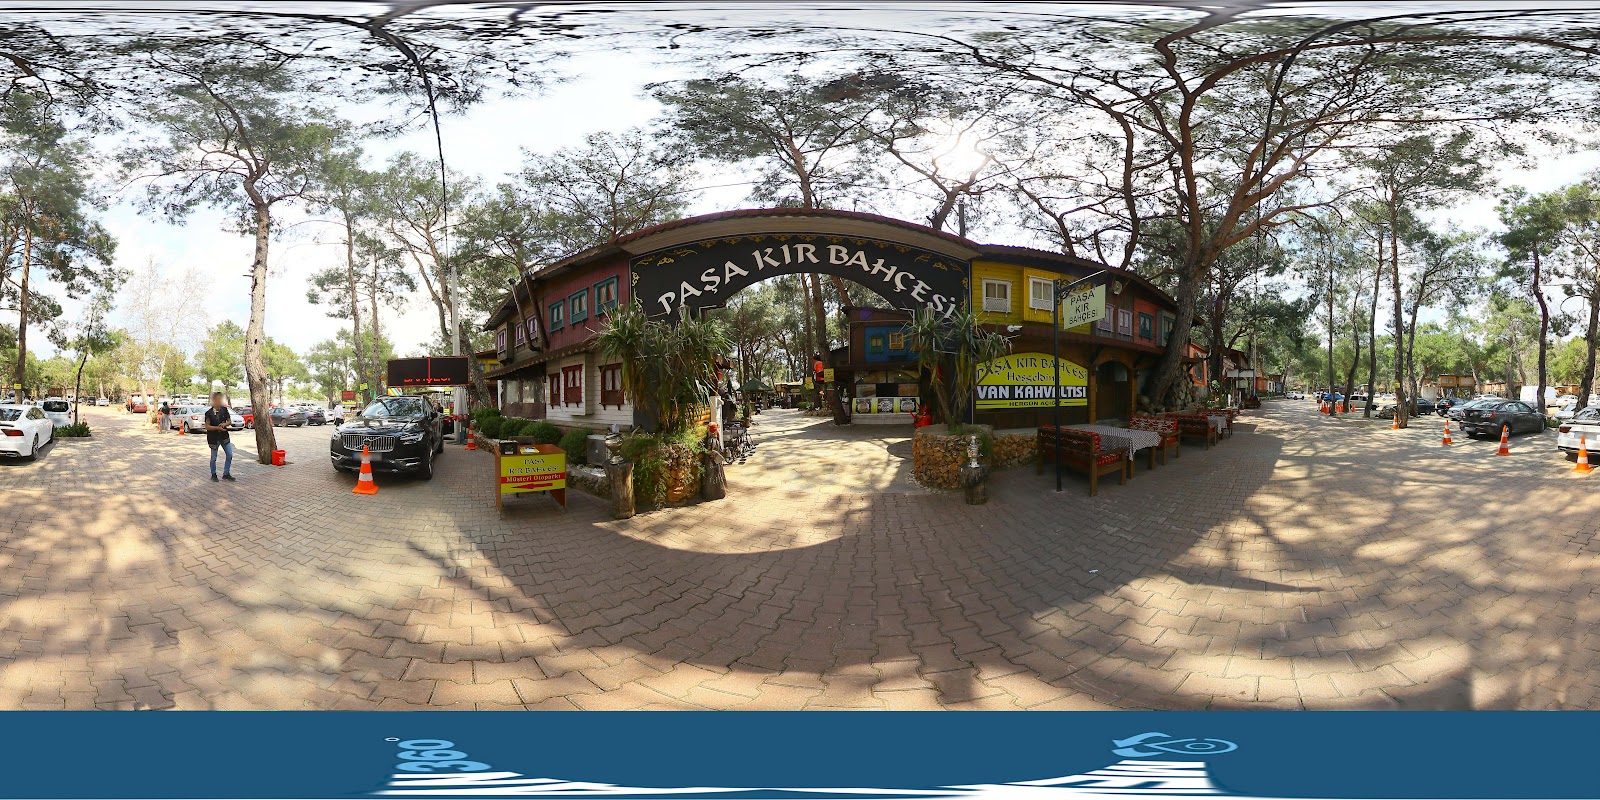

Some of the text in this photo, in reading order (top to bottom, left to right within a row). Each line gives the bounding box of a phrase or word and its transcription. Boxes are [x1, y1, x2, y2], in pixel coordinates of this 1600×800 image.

[657, 243, 958, 320] PAŞA KIR BAHÇESİ
[1075, 302, 1089, 315] KIR
[1069, 307, 1098, 325] BAHÇESİ
[1016, 357, 1038, 369] KIR
[976, 385, 1010, 399] VAN
[506, 473, 561, 483] Müşteri Otoparkı
